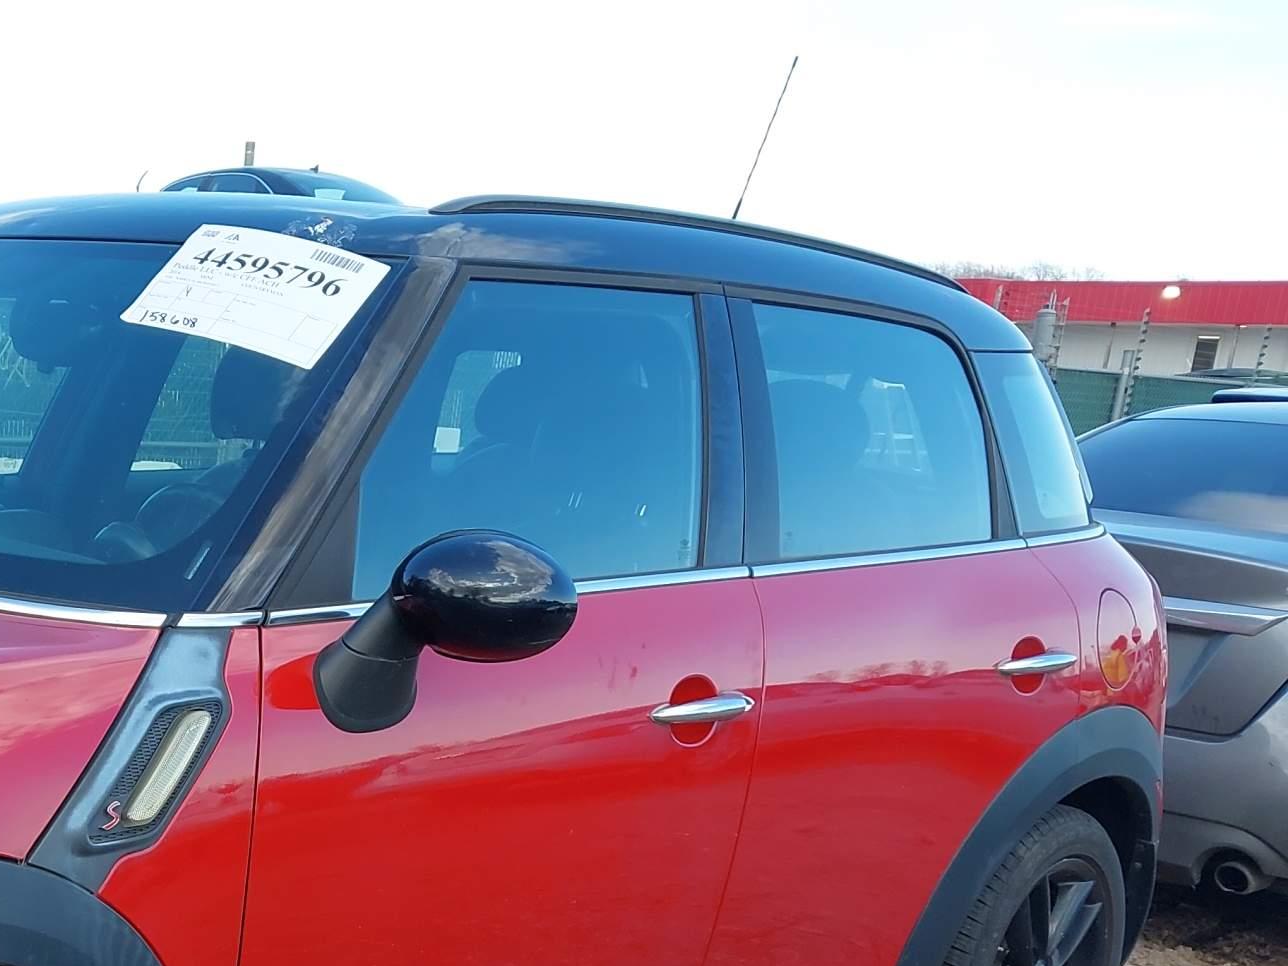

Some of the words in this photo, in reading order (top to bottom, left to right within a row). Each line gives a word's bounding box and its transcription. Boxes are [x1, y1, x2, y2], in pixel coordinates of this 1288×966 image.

[193, 248, 349, 297] 44595796
[139, 310, 198, 329] 158608
[100, 801, 121, 831] S
